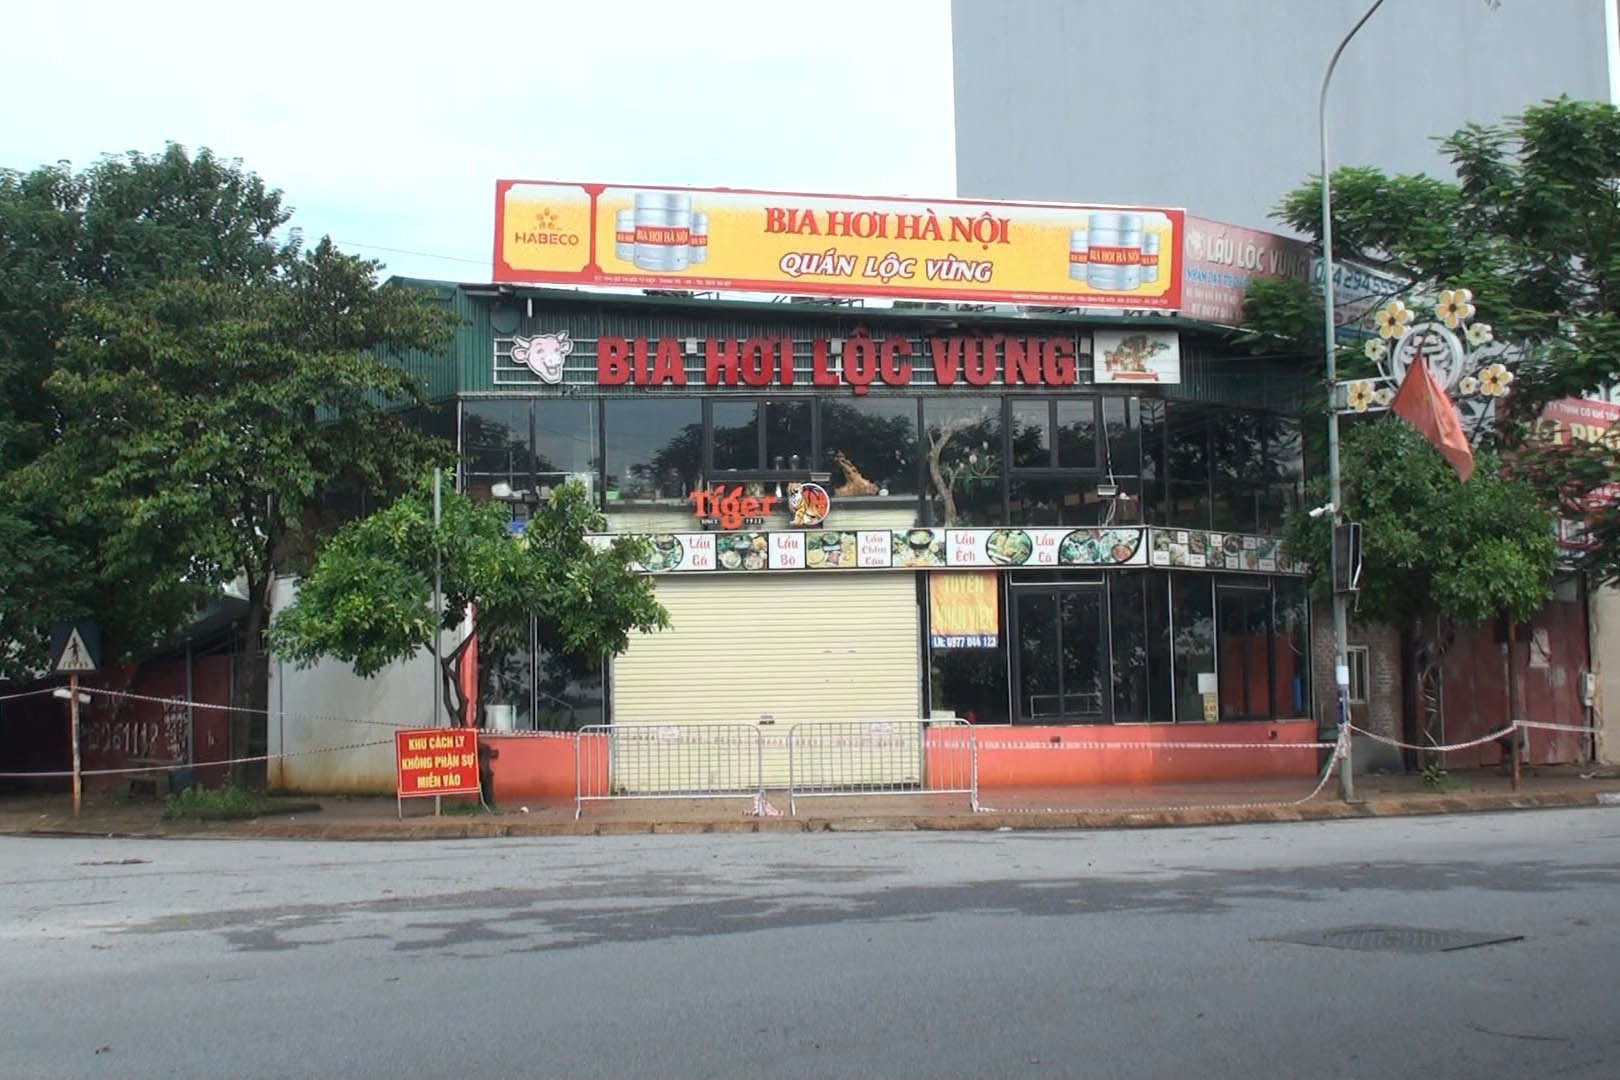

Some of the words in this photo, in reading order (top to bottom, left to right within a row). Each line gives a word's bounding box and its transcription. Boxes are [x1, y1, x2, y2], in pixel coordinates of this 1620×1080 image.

[515, 232, 579, 246] HABECO
[764, 207, 821, 236] BIA
[825, 210, 889, 239] HƠI
[895, 208, 945, 241] HÀ
[949, 211, 1011, 250] NỘI
[779, 247, 858, 278] QUÁN
[862, 252, 917, 284] LỘC
[926, 253, 993, 283] VỪNG
[597, 336, 686, 386] BIA
[704, 333, 794, 386] HƠI
[812, 327, 912, 396] LỘC
[930, 329, 1075, 386] VỪNG
[689, 484, 776, 529] Tiger
[408, 737, 427, 751] KHU
[429, 735, 453, 750] CÁCH
[455, 735, 465, 748] LY
[402, 755, 432, 770] KHÔNG
[443, 772, 461, 787] VÀO
